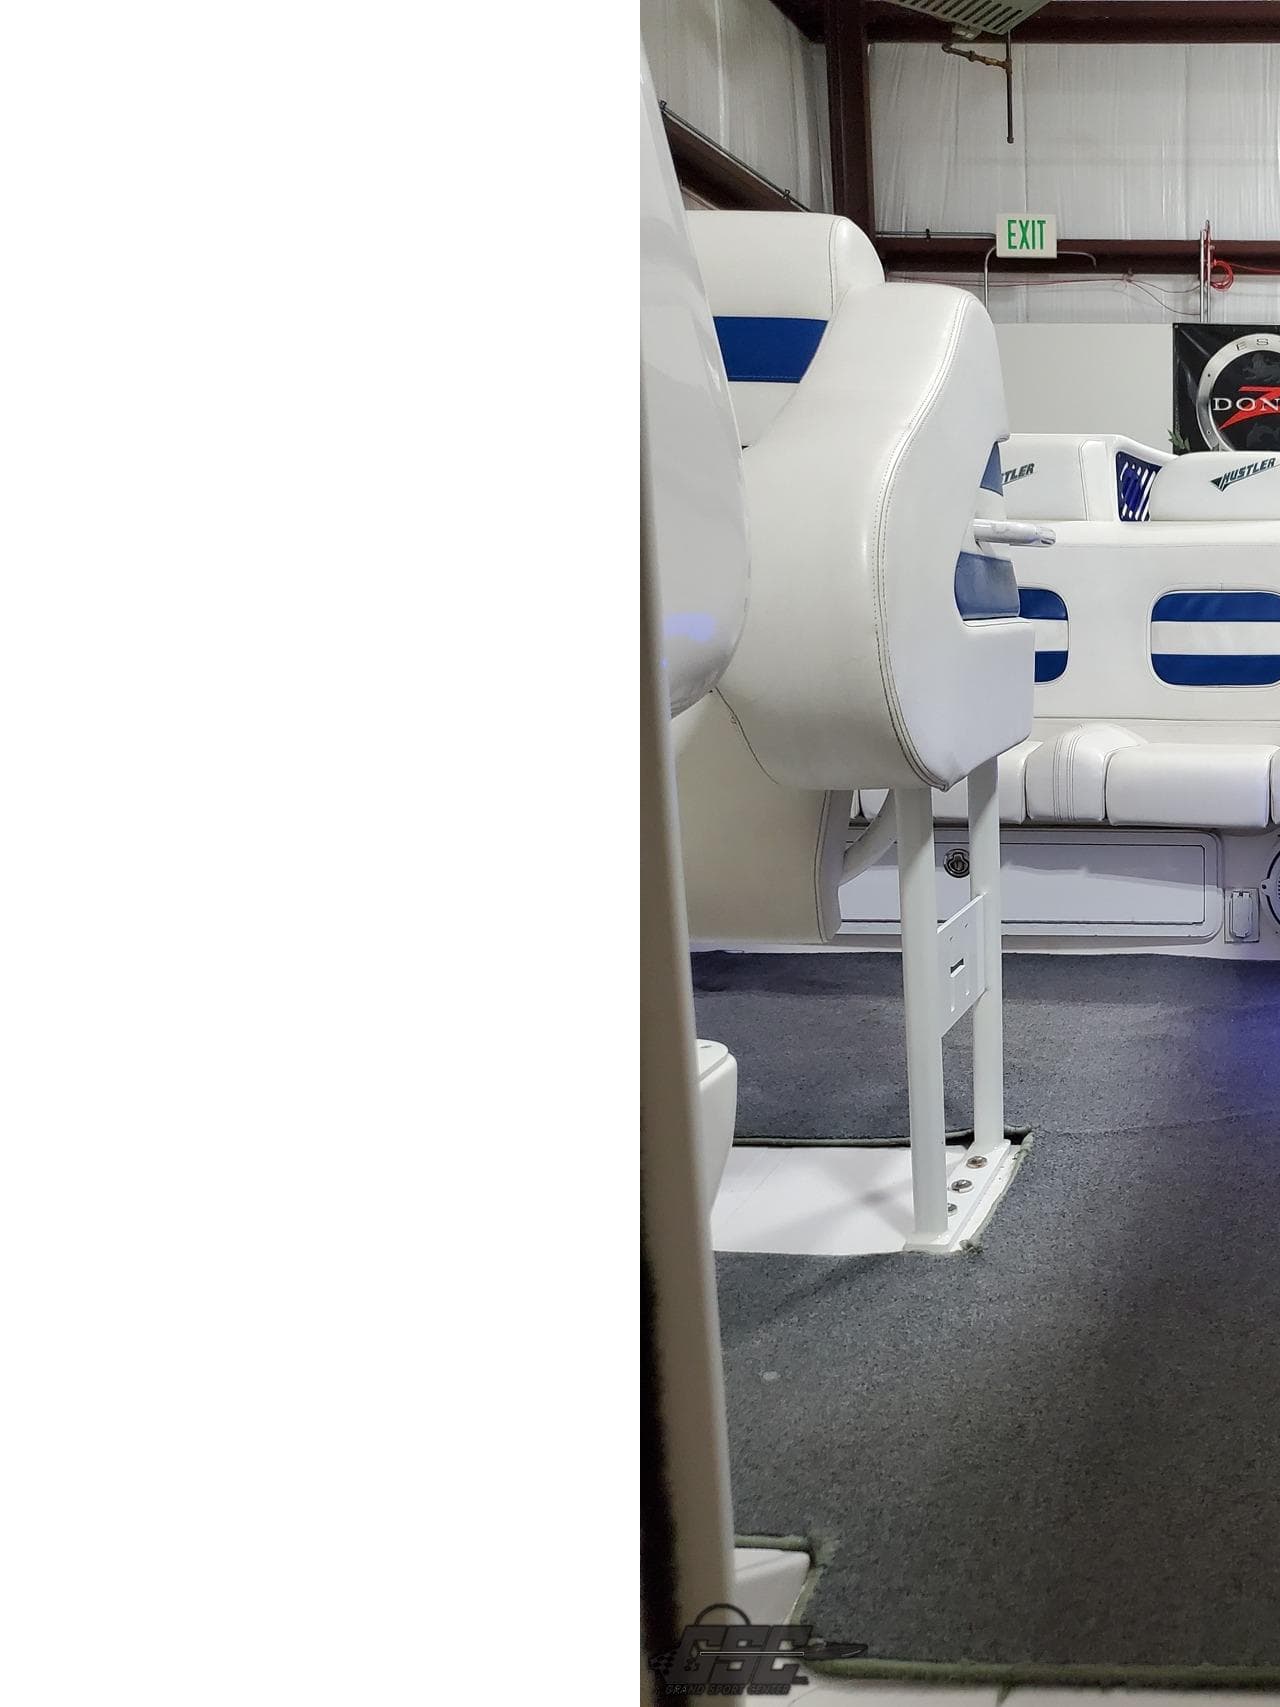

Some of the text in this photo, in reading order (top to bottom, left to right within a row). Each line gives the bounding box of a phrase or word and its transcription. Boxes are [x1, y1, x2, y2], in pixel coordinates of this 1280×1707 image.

[1007, 219, 1047, 250] EXIT
[1001, 462, 1036, 483] TLER
[1218, 457, 1278, 488] HUSTLER
